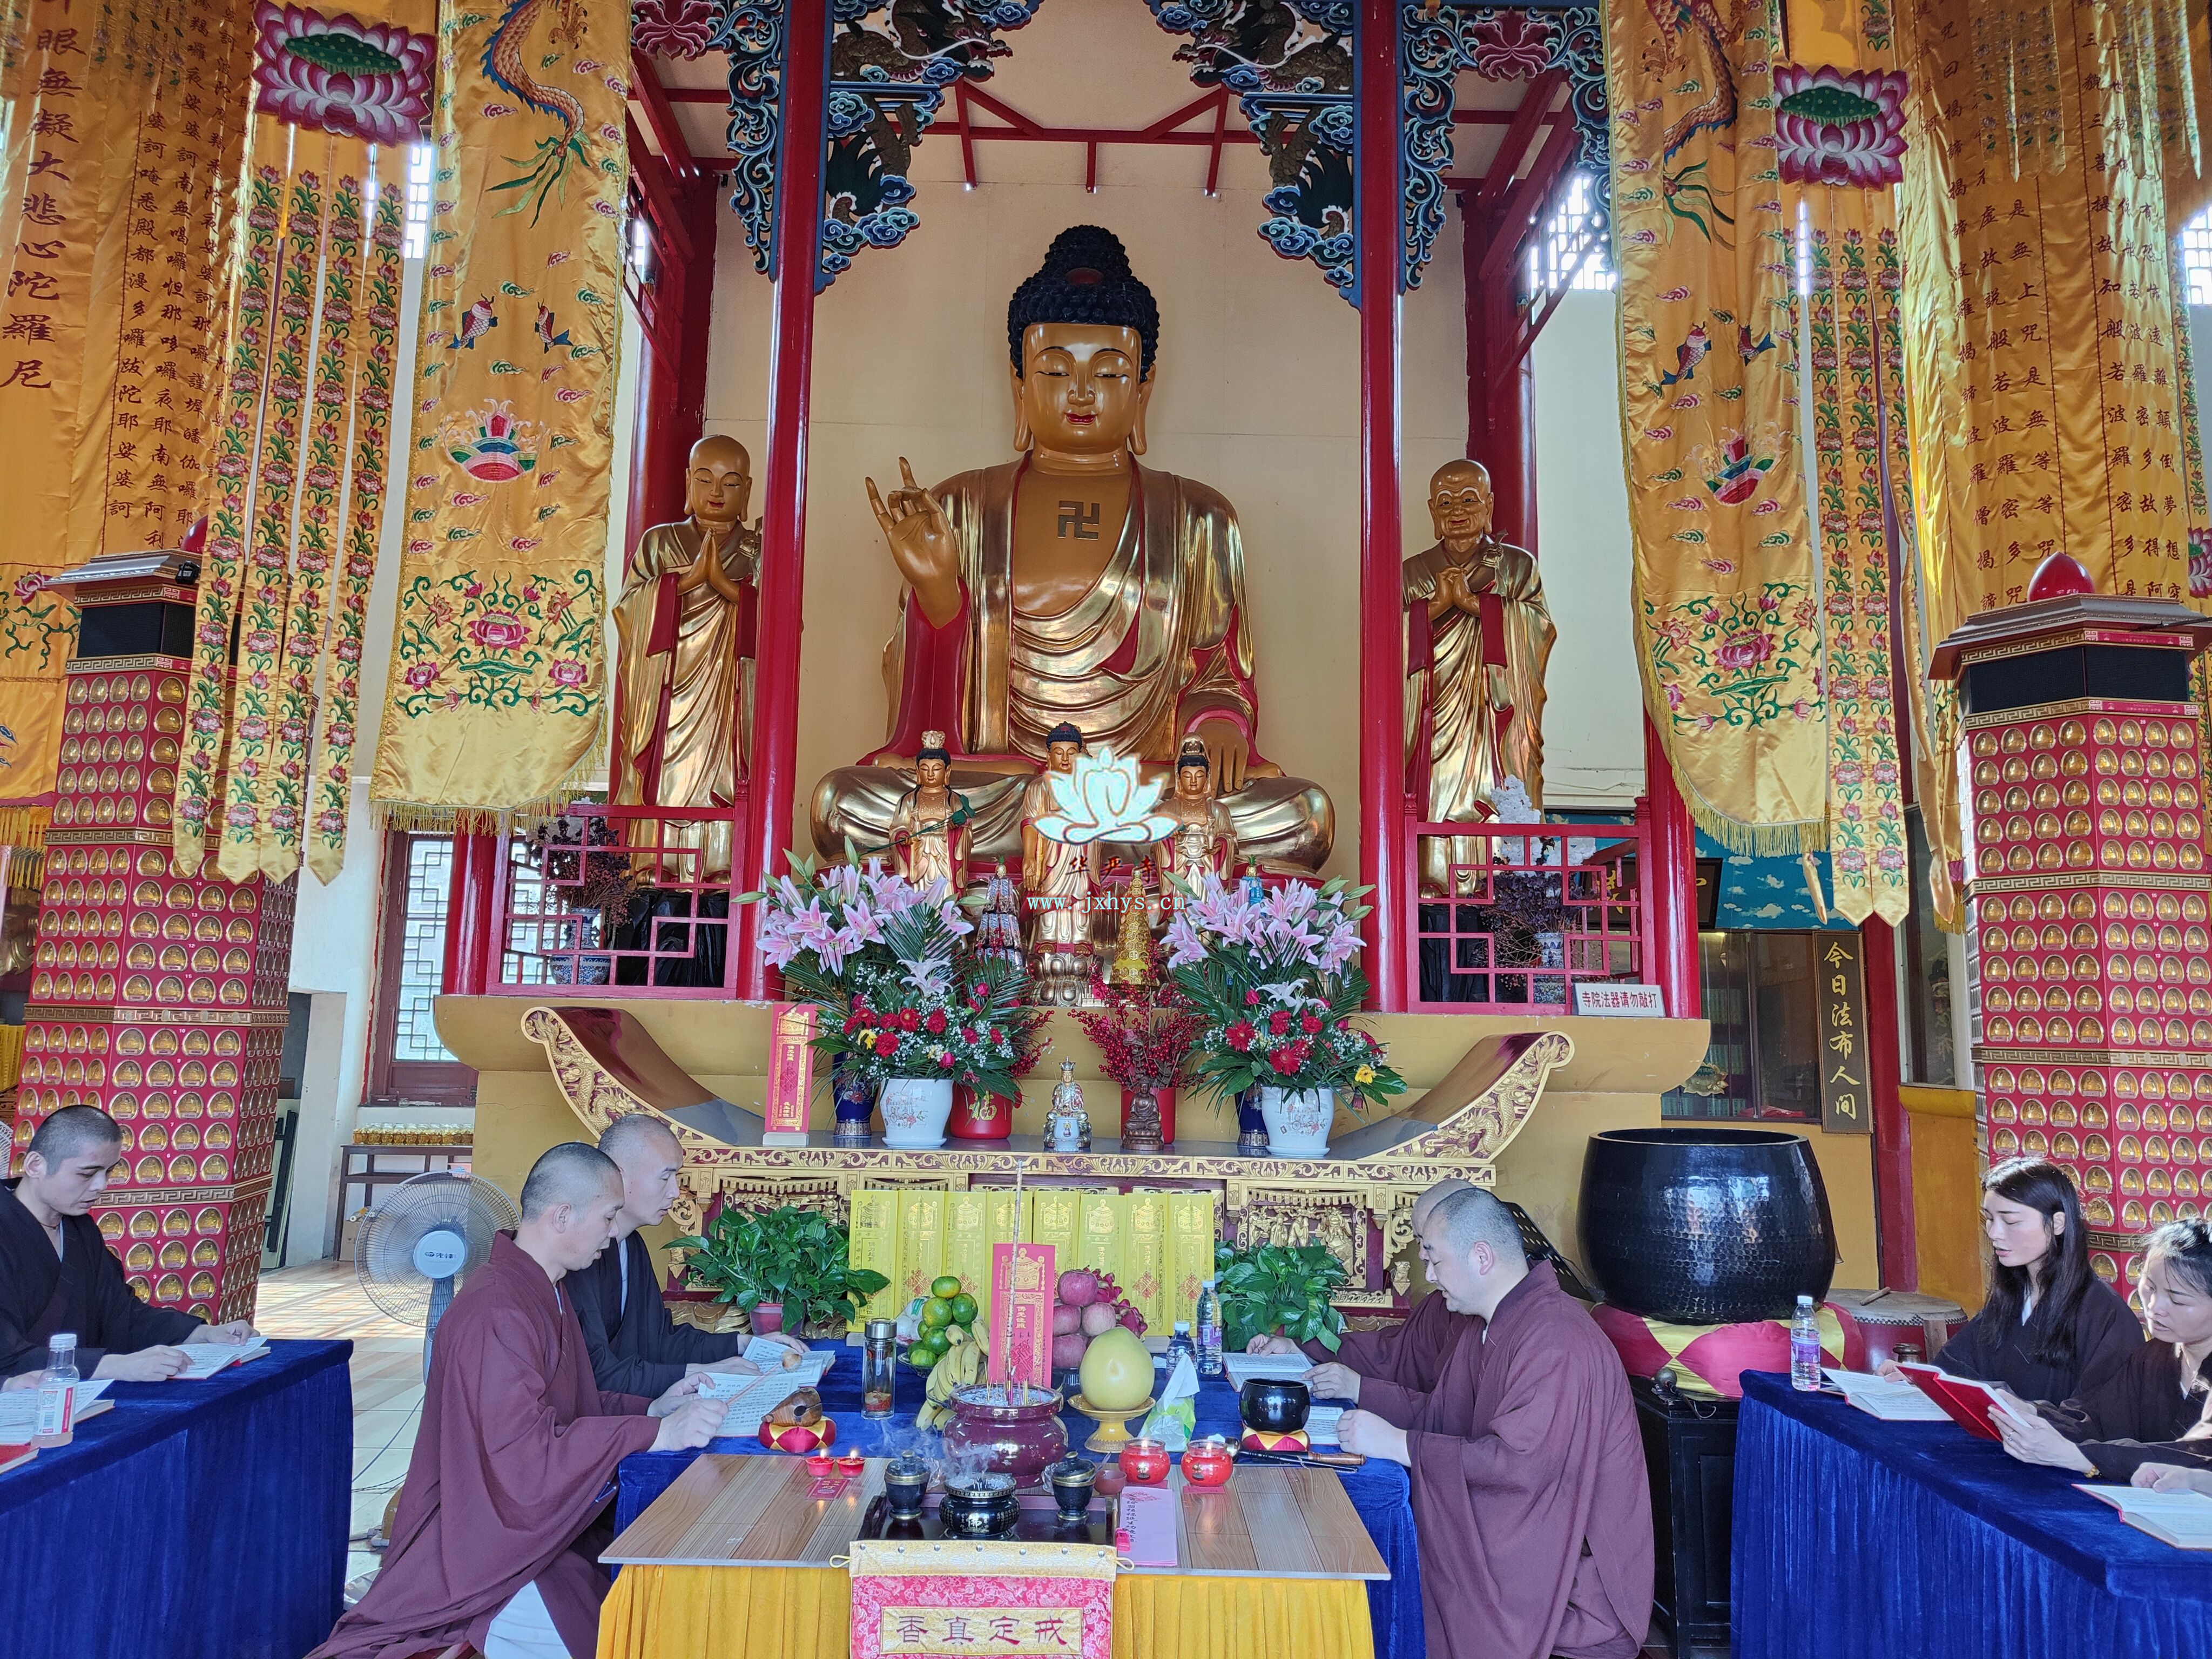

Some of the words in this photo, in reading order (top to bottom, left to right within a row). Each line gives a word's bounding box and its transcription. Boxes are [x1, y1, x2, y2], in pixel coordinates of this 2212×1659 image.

[0, 0, 86, 389] 眼無礙大悲心陀羅尼
[1939, 0, 1997, 611] 咒曰揭諦揭諦波羅揭諦波羅僧揭諦
[1582, 990, 1657, 1009] 寺院法器请勿敲打
[1823, 941, 1861, 1121] 今日法布人間
